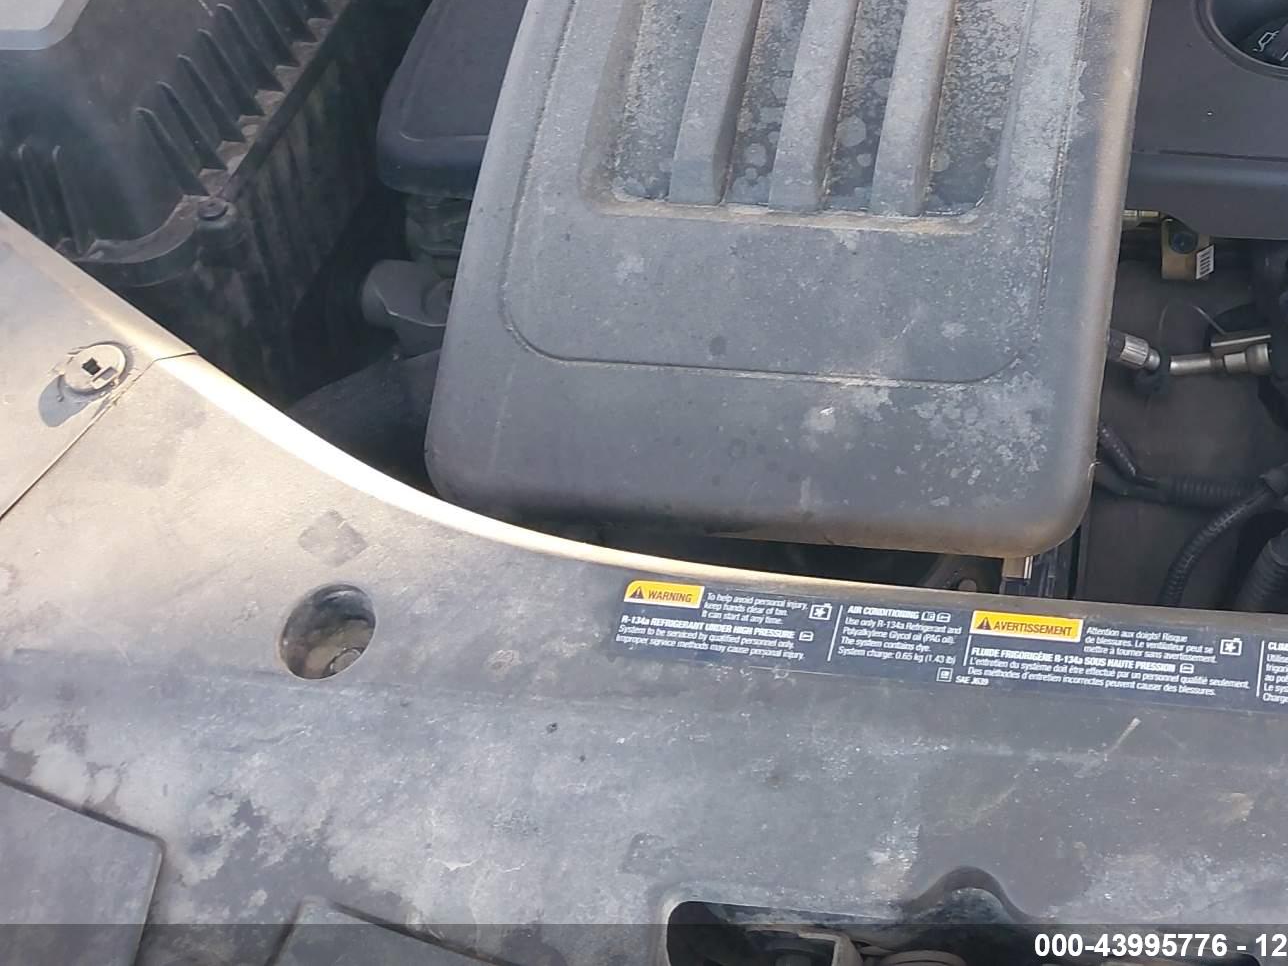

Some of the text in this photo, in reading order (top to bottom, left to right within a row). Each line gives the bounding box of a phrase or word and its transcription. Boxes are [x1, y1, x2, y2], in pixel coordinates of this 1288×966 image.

[648, 590, 692, 603] WARNING
[717, 593, 732, 604] help
[733, 595, 753, 604] avoid
[754, 598, 786, 607] personal
[704, 600, 721, 611] keep
[723, 602, 746, 612] hands
[723, 611, 740, 620] start
[863, 607, 920, 619] CONDITIONING
[622, 615, 650, 626] R-134a
[651, 617, 704, 630] REFRIGERANT
[704, 622, 732, 633] UNDER
[754, 627, 796, 639] PRESSURE
[860, 618, 876, 629] only
[877, 619, 904, 629] R-134a
[906, 621, 946, 633] Refrigerant
[947, 625, 962, 634] and
[994, 621, 1072, 636] AVERTISSEMENT
[1087, 626, 1120, 637] Attention
[618, 624, 646, 635] System
[666, 630, 698, 639] serviced
[741, 636, 778, 646] personnel
[889, 630, 912, 641] Glycol
[923, 632, 940, 643] (PAG
[856, 638, 882, 647] system
[884, 640, 914, 650] contains
[1186, 644, 1202, 654] peut
[838, 646, 866, 657] System
[972, 647, 1000, 658] FLUIDE
[1054, 654, 1082, 665] R-134a
[1084, 657, 1106, 667] SOUS
[1108, 659, 1134, 669] HAUTE
[1135, 661, 1176, 672] PRESSION
[955, 675, 971, 684] SAE
